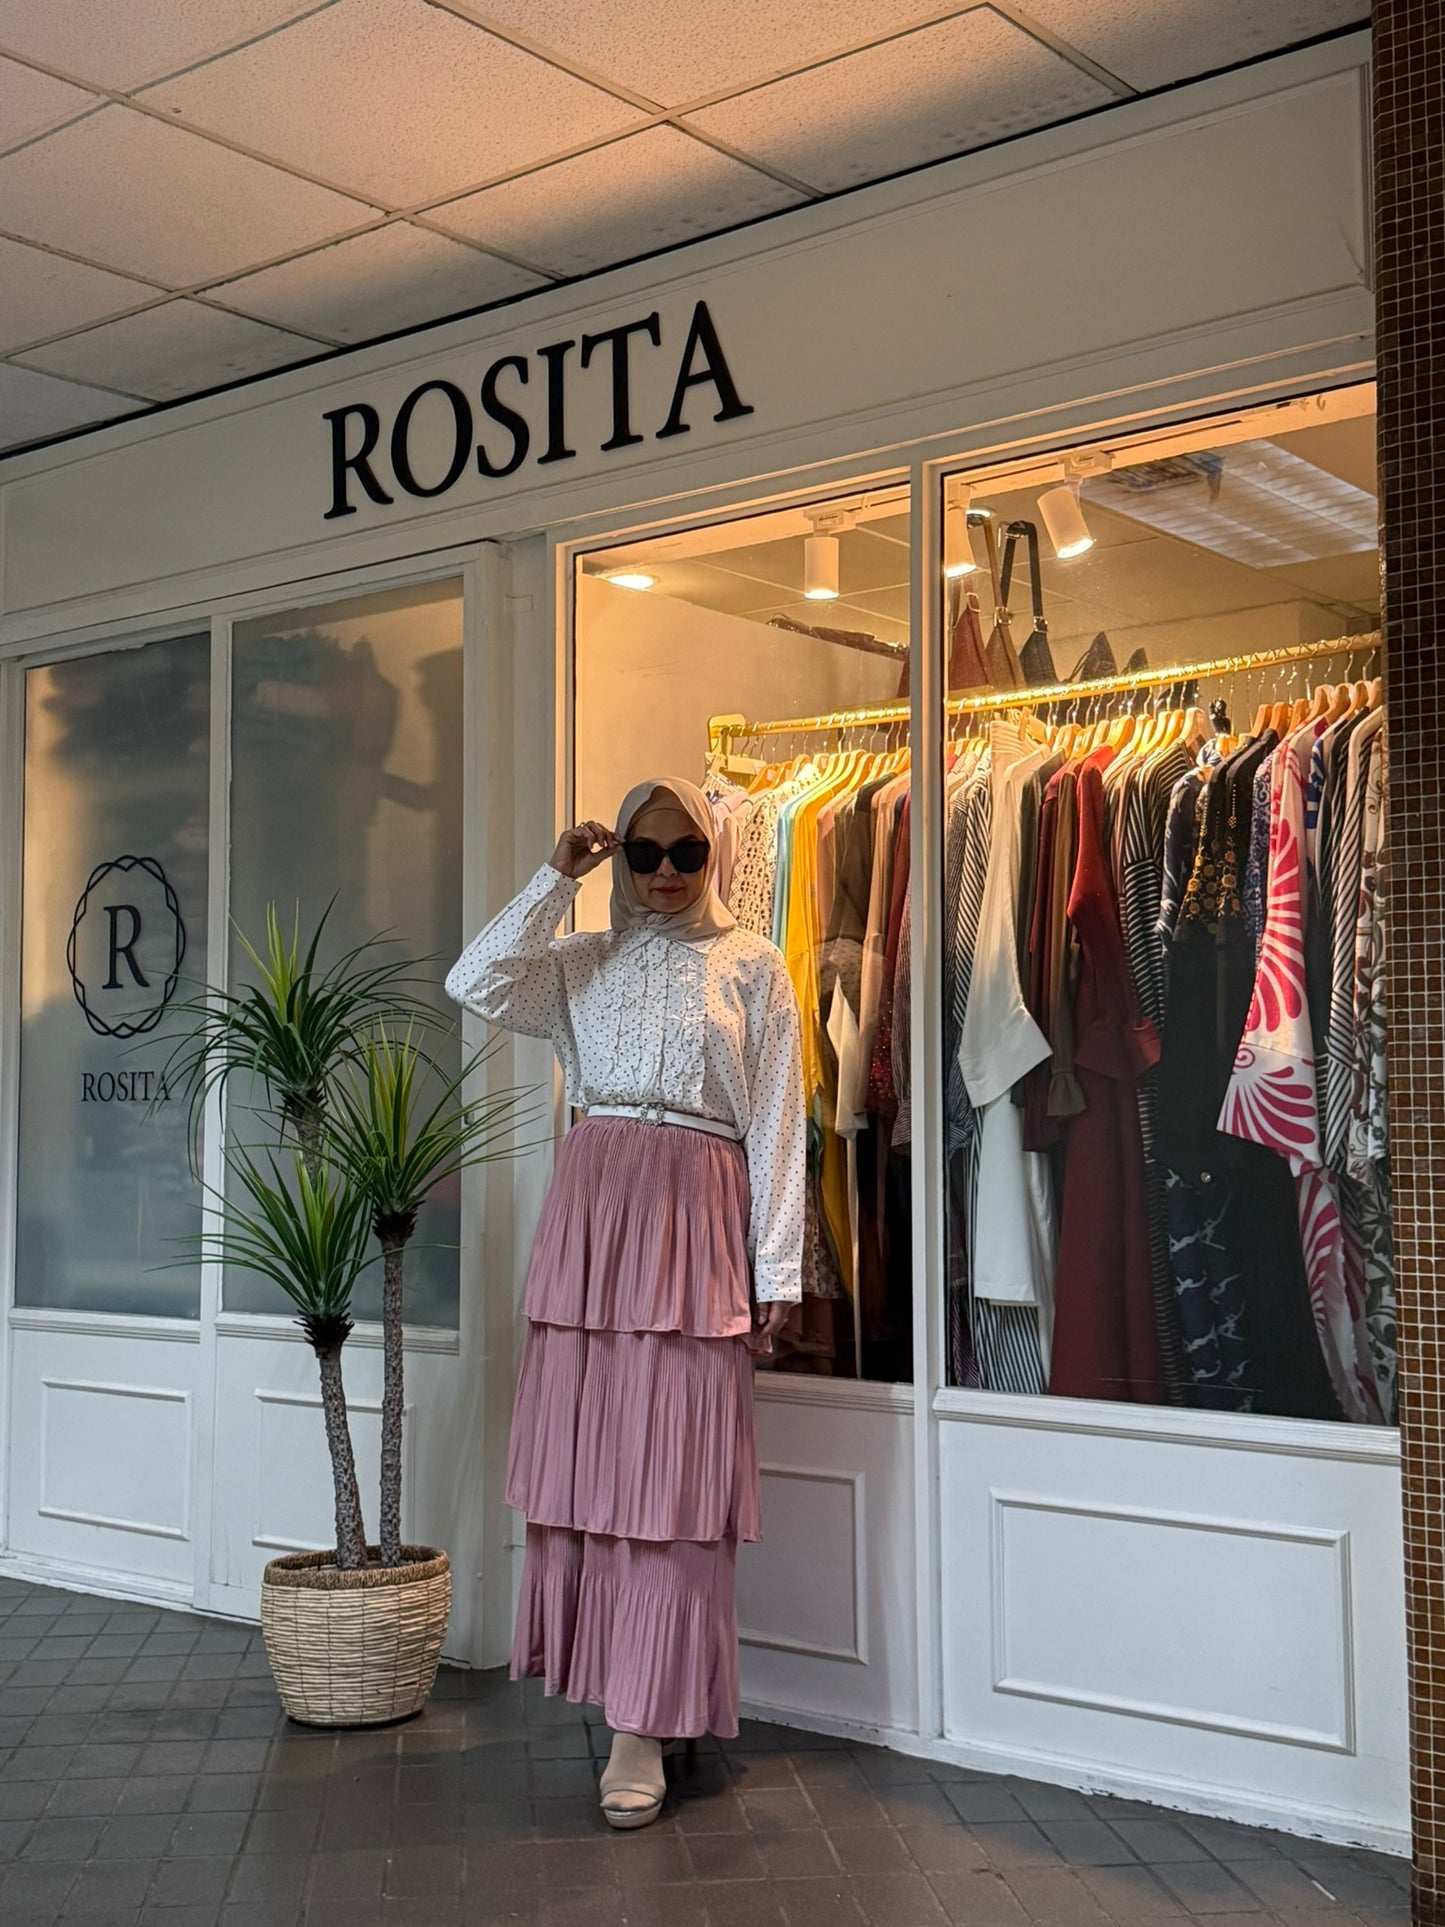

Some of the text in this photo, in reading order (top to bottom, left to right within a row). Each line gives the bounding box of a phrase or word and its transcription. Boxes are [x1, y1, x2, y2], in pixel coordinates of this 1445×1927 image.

[323, 300, 754, 519] ROSITA
[102, 904, 150, 989] R
[81, 1071, 172, 1103] ROSITA
